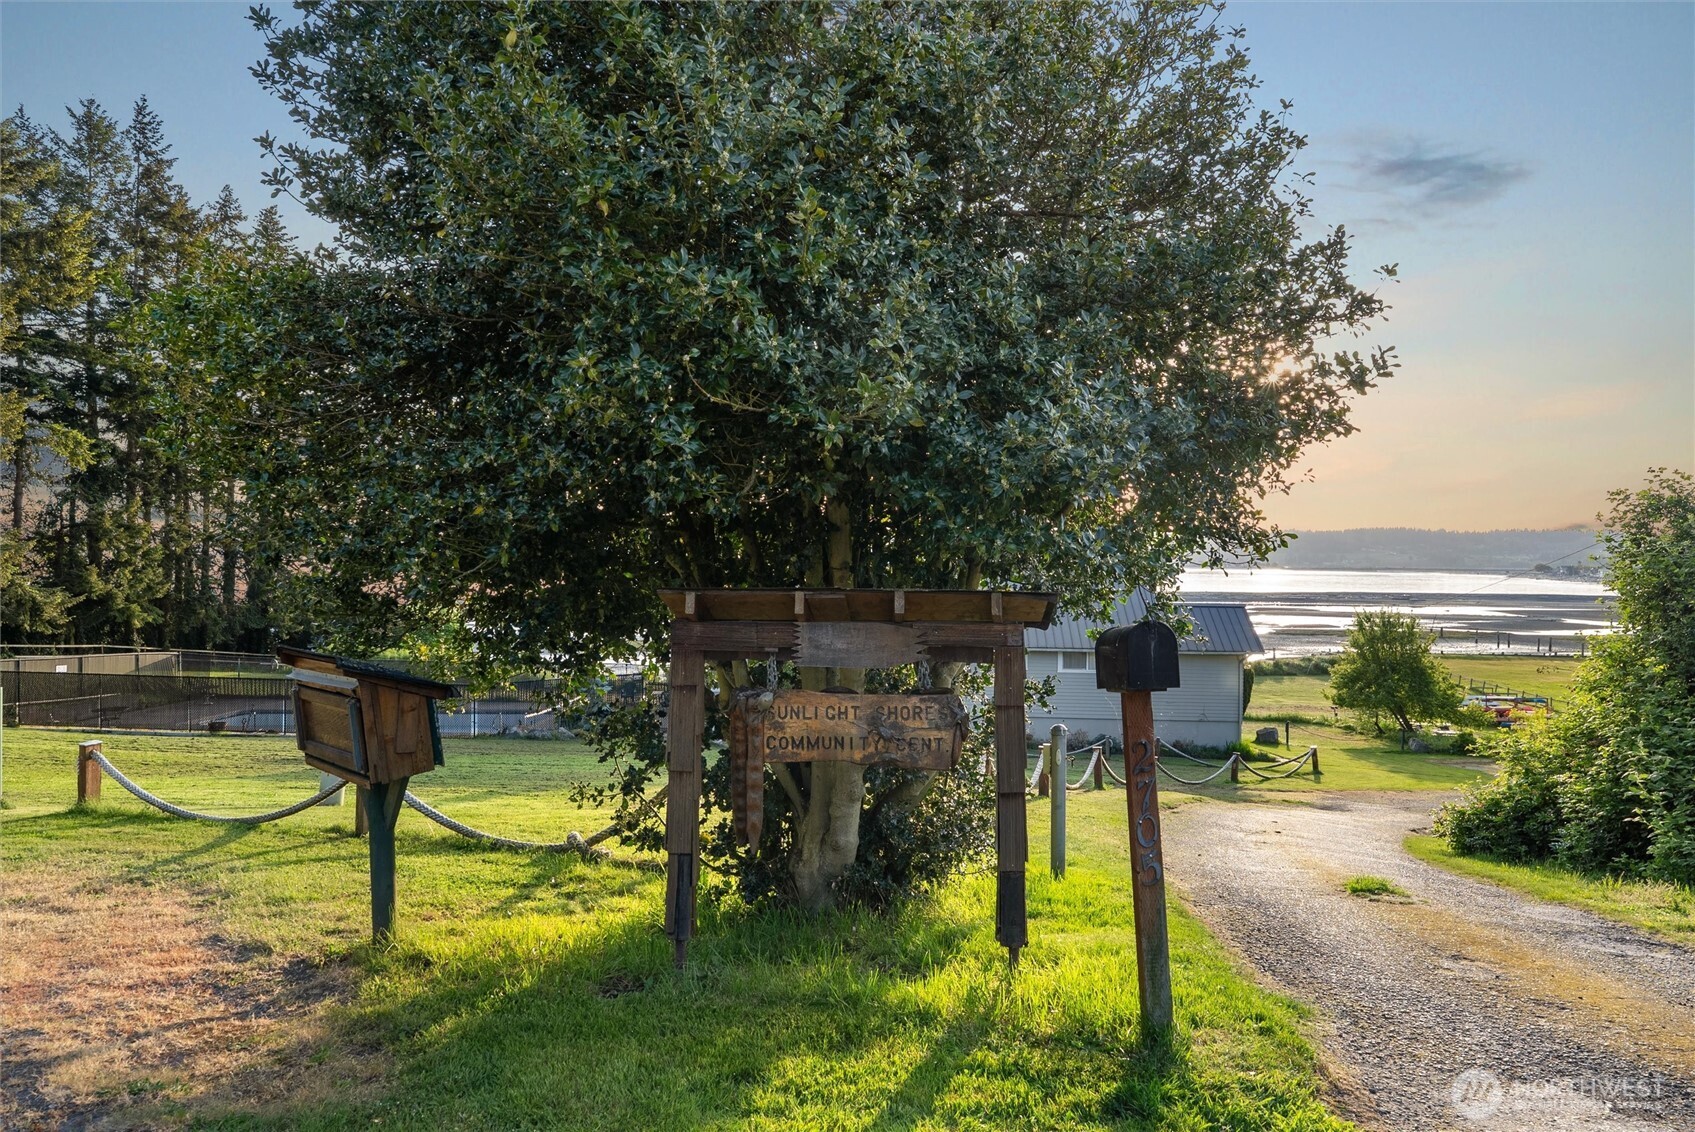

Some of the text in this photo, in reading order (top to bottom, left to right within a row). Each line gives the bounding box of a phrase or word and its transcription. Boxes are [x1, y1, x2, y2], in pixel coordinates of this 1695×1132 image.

[875, 705, 948, 721] SHORES
[766, 735, 881, 752] COMMUNITY
[1132, 739, 1162, 887] 2705
